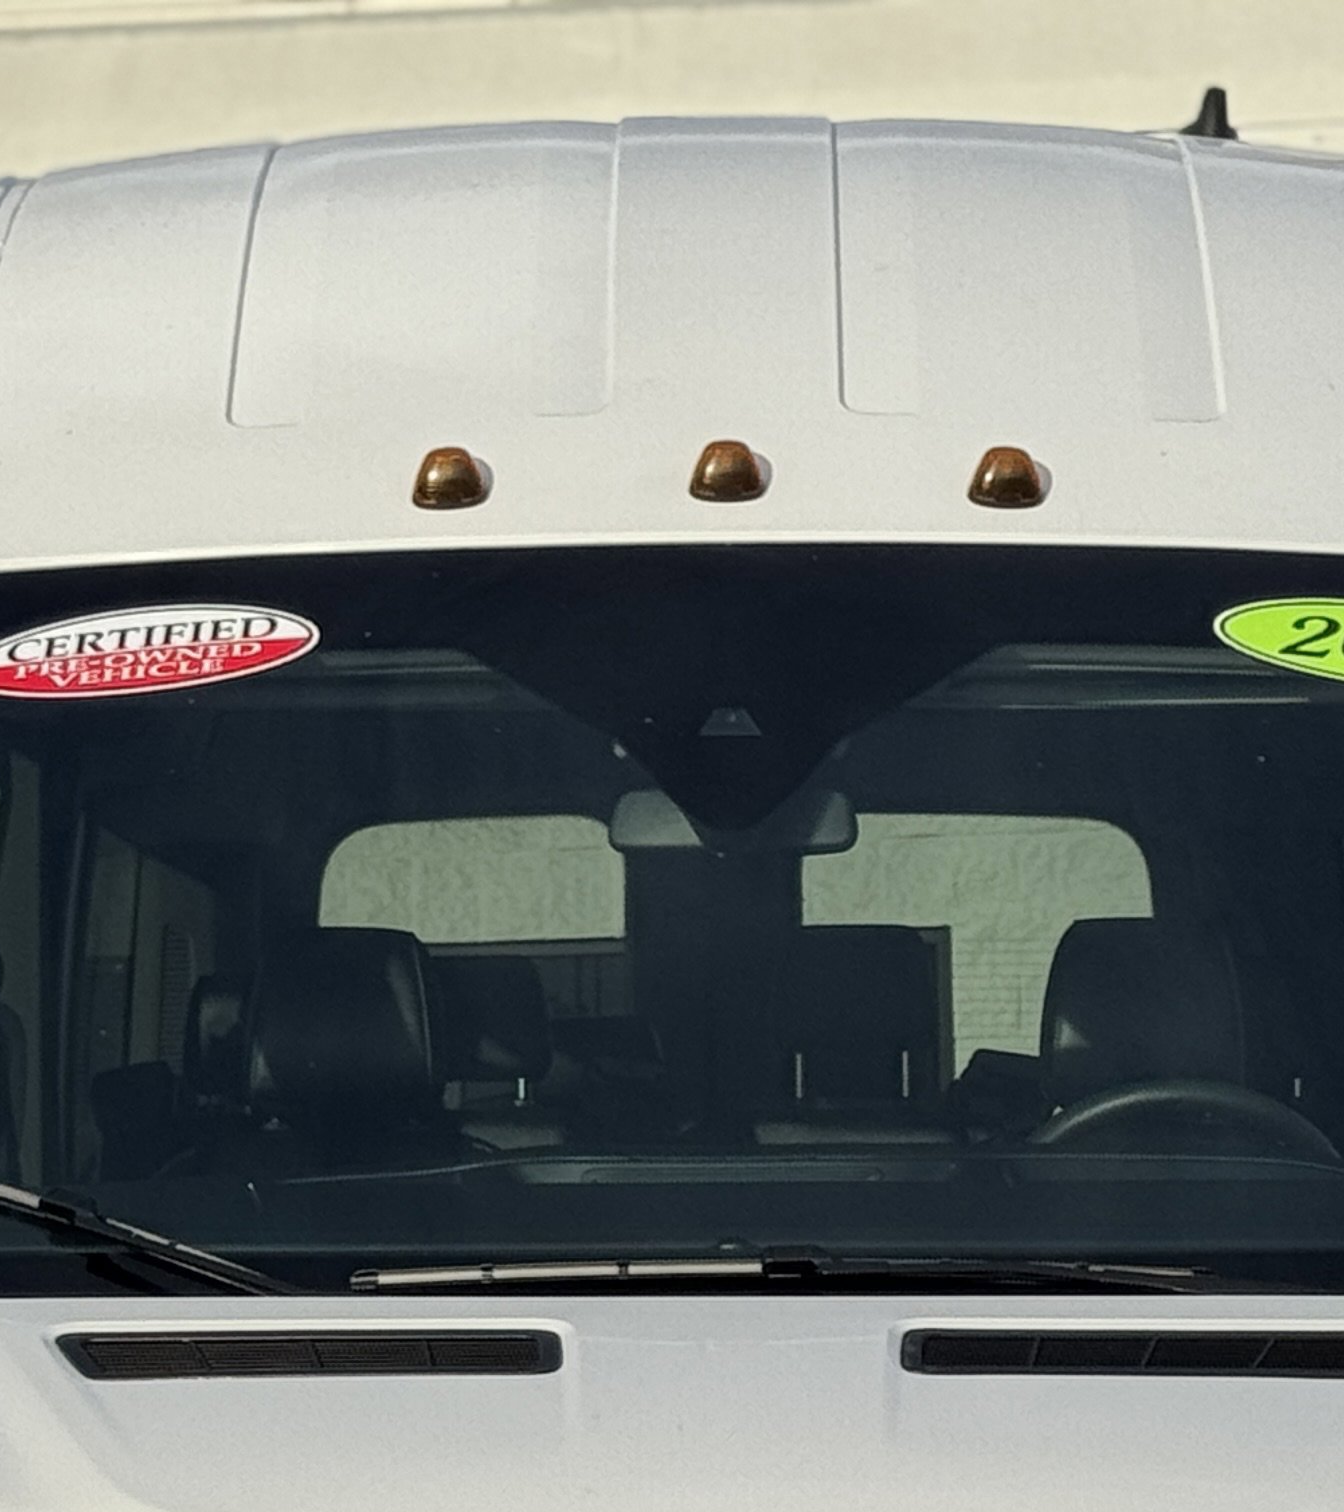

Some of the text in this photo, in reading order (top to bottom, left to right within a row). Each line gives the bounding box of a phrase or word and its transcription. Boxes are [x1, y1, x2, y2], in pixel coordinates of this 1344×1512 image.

[7, 616, 278, 663] CERTIFIED
[14, 642, 263, 680] PRE-OWNED
[47, 659, 225, 688] VEHICLE
